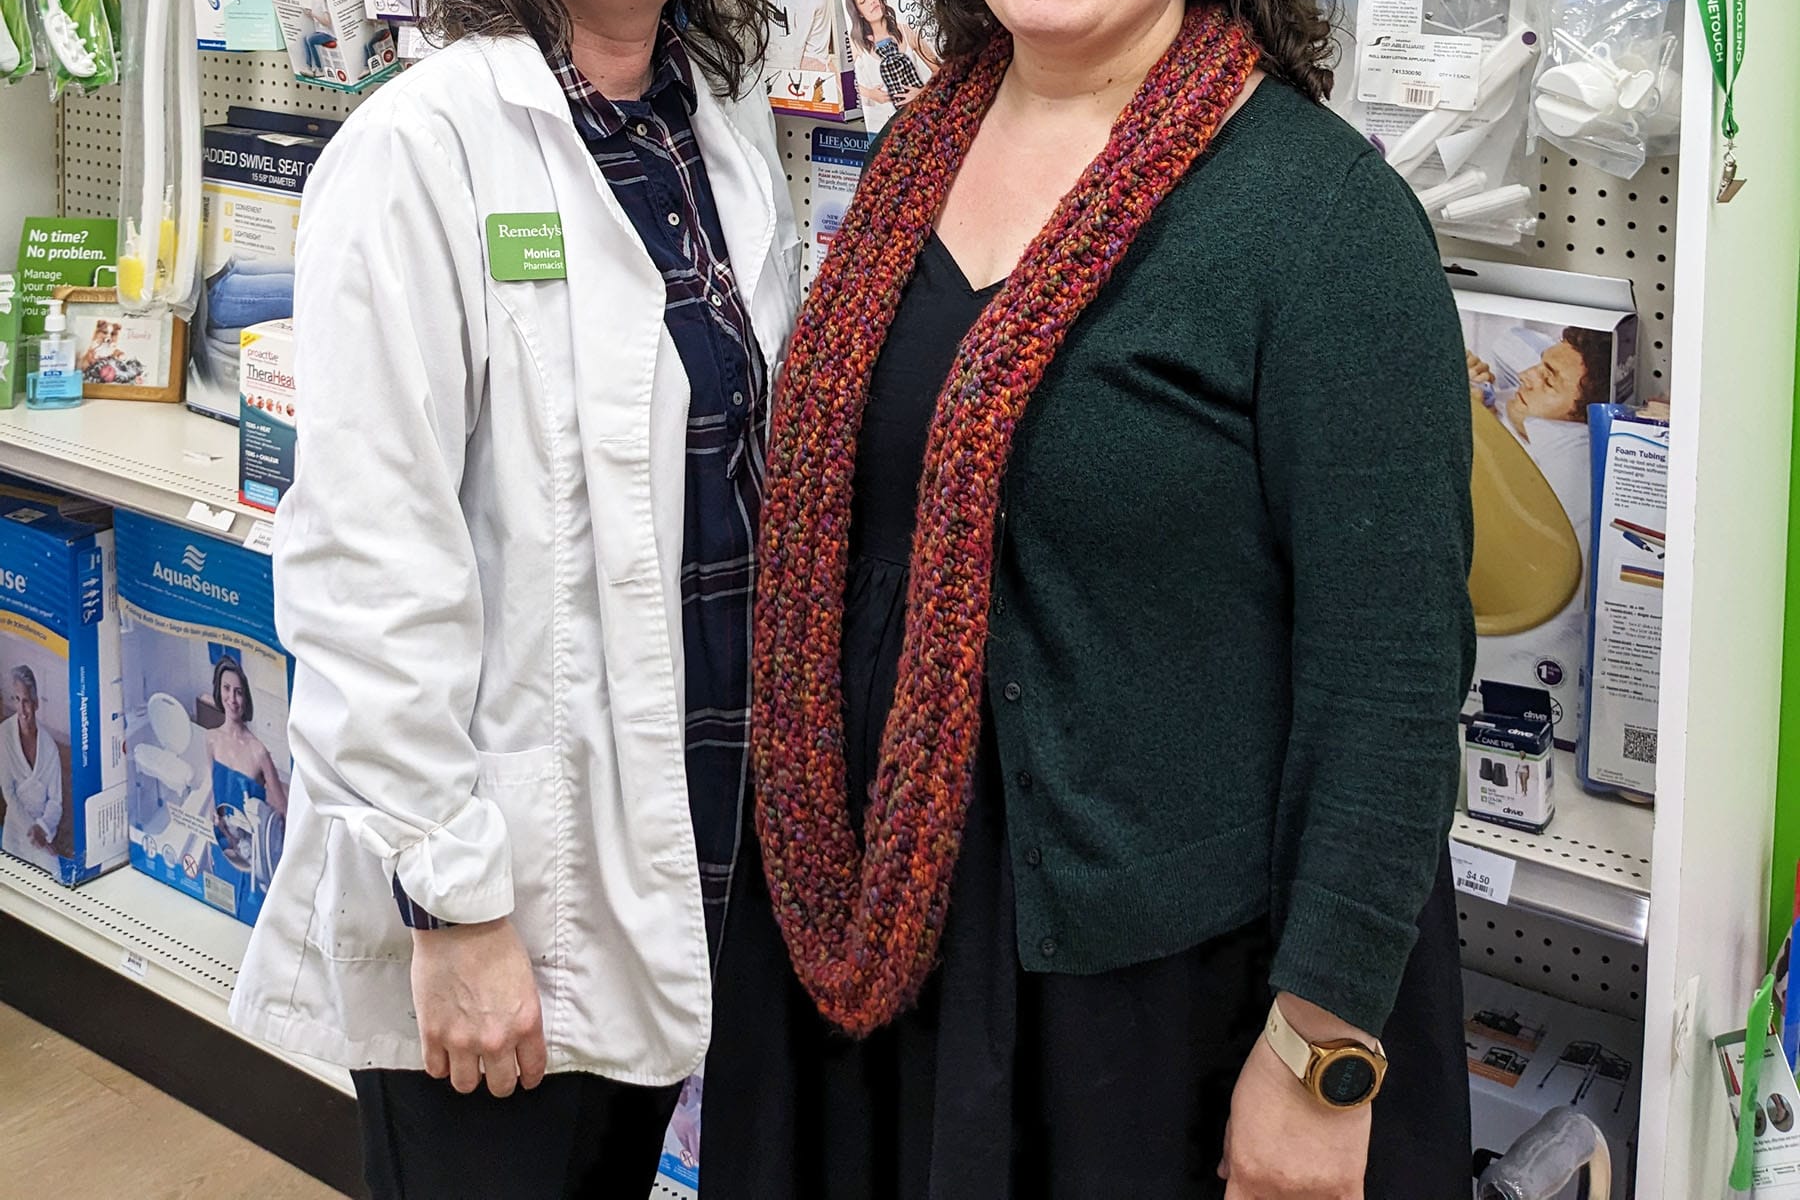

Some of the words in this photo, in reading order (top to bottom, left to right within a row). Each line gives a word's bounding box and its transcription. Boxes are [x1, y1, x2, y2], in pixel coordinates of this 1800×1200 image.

[240, 152, 277, 173] SWIVEL
[278, 158, 305, 176] SEAT
[269, 175, 297, 187] DIAMETER
[29, 229, 48, 243] No
[51, 230, 88, 243] time?
[27, 245, 46, 258] No
[48, 247, 107, 261] problem.
[523, 248, 561, 259] Monica
[523, 261, 564, 271] Pharmacist
[24, 268, 62, 281] Manage
[22, 282, 44, 293] your
[1615, 446, 1637, 457] Foam
[1639, 450, 1666, 463] Tubing
[152, 560, 240, 606] AquaSense
[1538, 664, 1547, 679] 1
[1507, 727, 1535, 738] drive
[1481, 736, 1499, 747] CANE
[1500, 739, 1515, 749] TIPS
[1502, 806, 1524, 817] drive
[1466, 870, 1490, 885] $4.50
